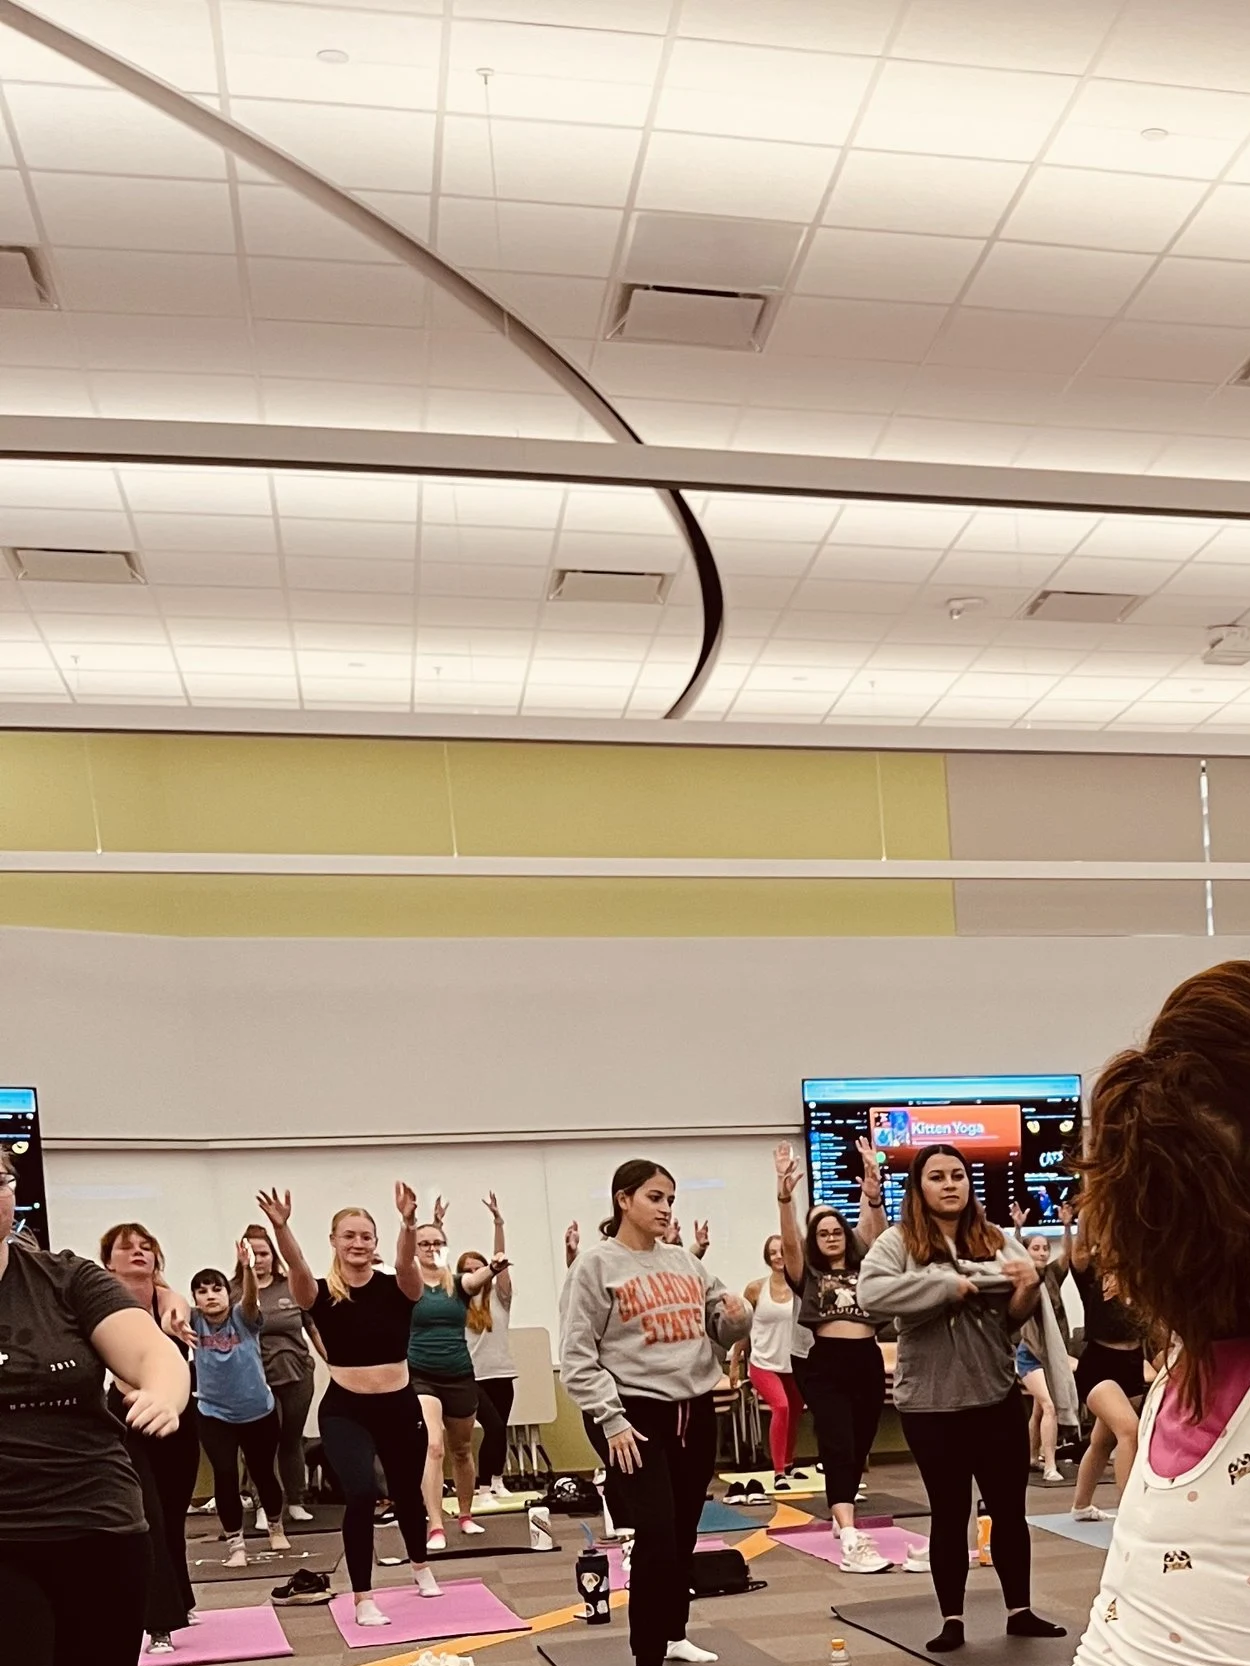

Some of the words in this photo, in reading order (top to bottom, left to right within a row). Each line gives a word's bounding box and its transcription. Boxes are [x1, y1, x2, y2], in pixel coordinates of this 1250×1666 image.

[911, 1121, 951, 1134] Kitten
[951, 1120, 985, 1137] Yoga
[616, 1271, 704, 1322] OKLAHOM
[642, 1308, 704, 1345] STATE
